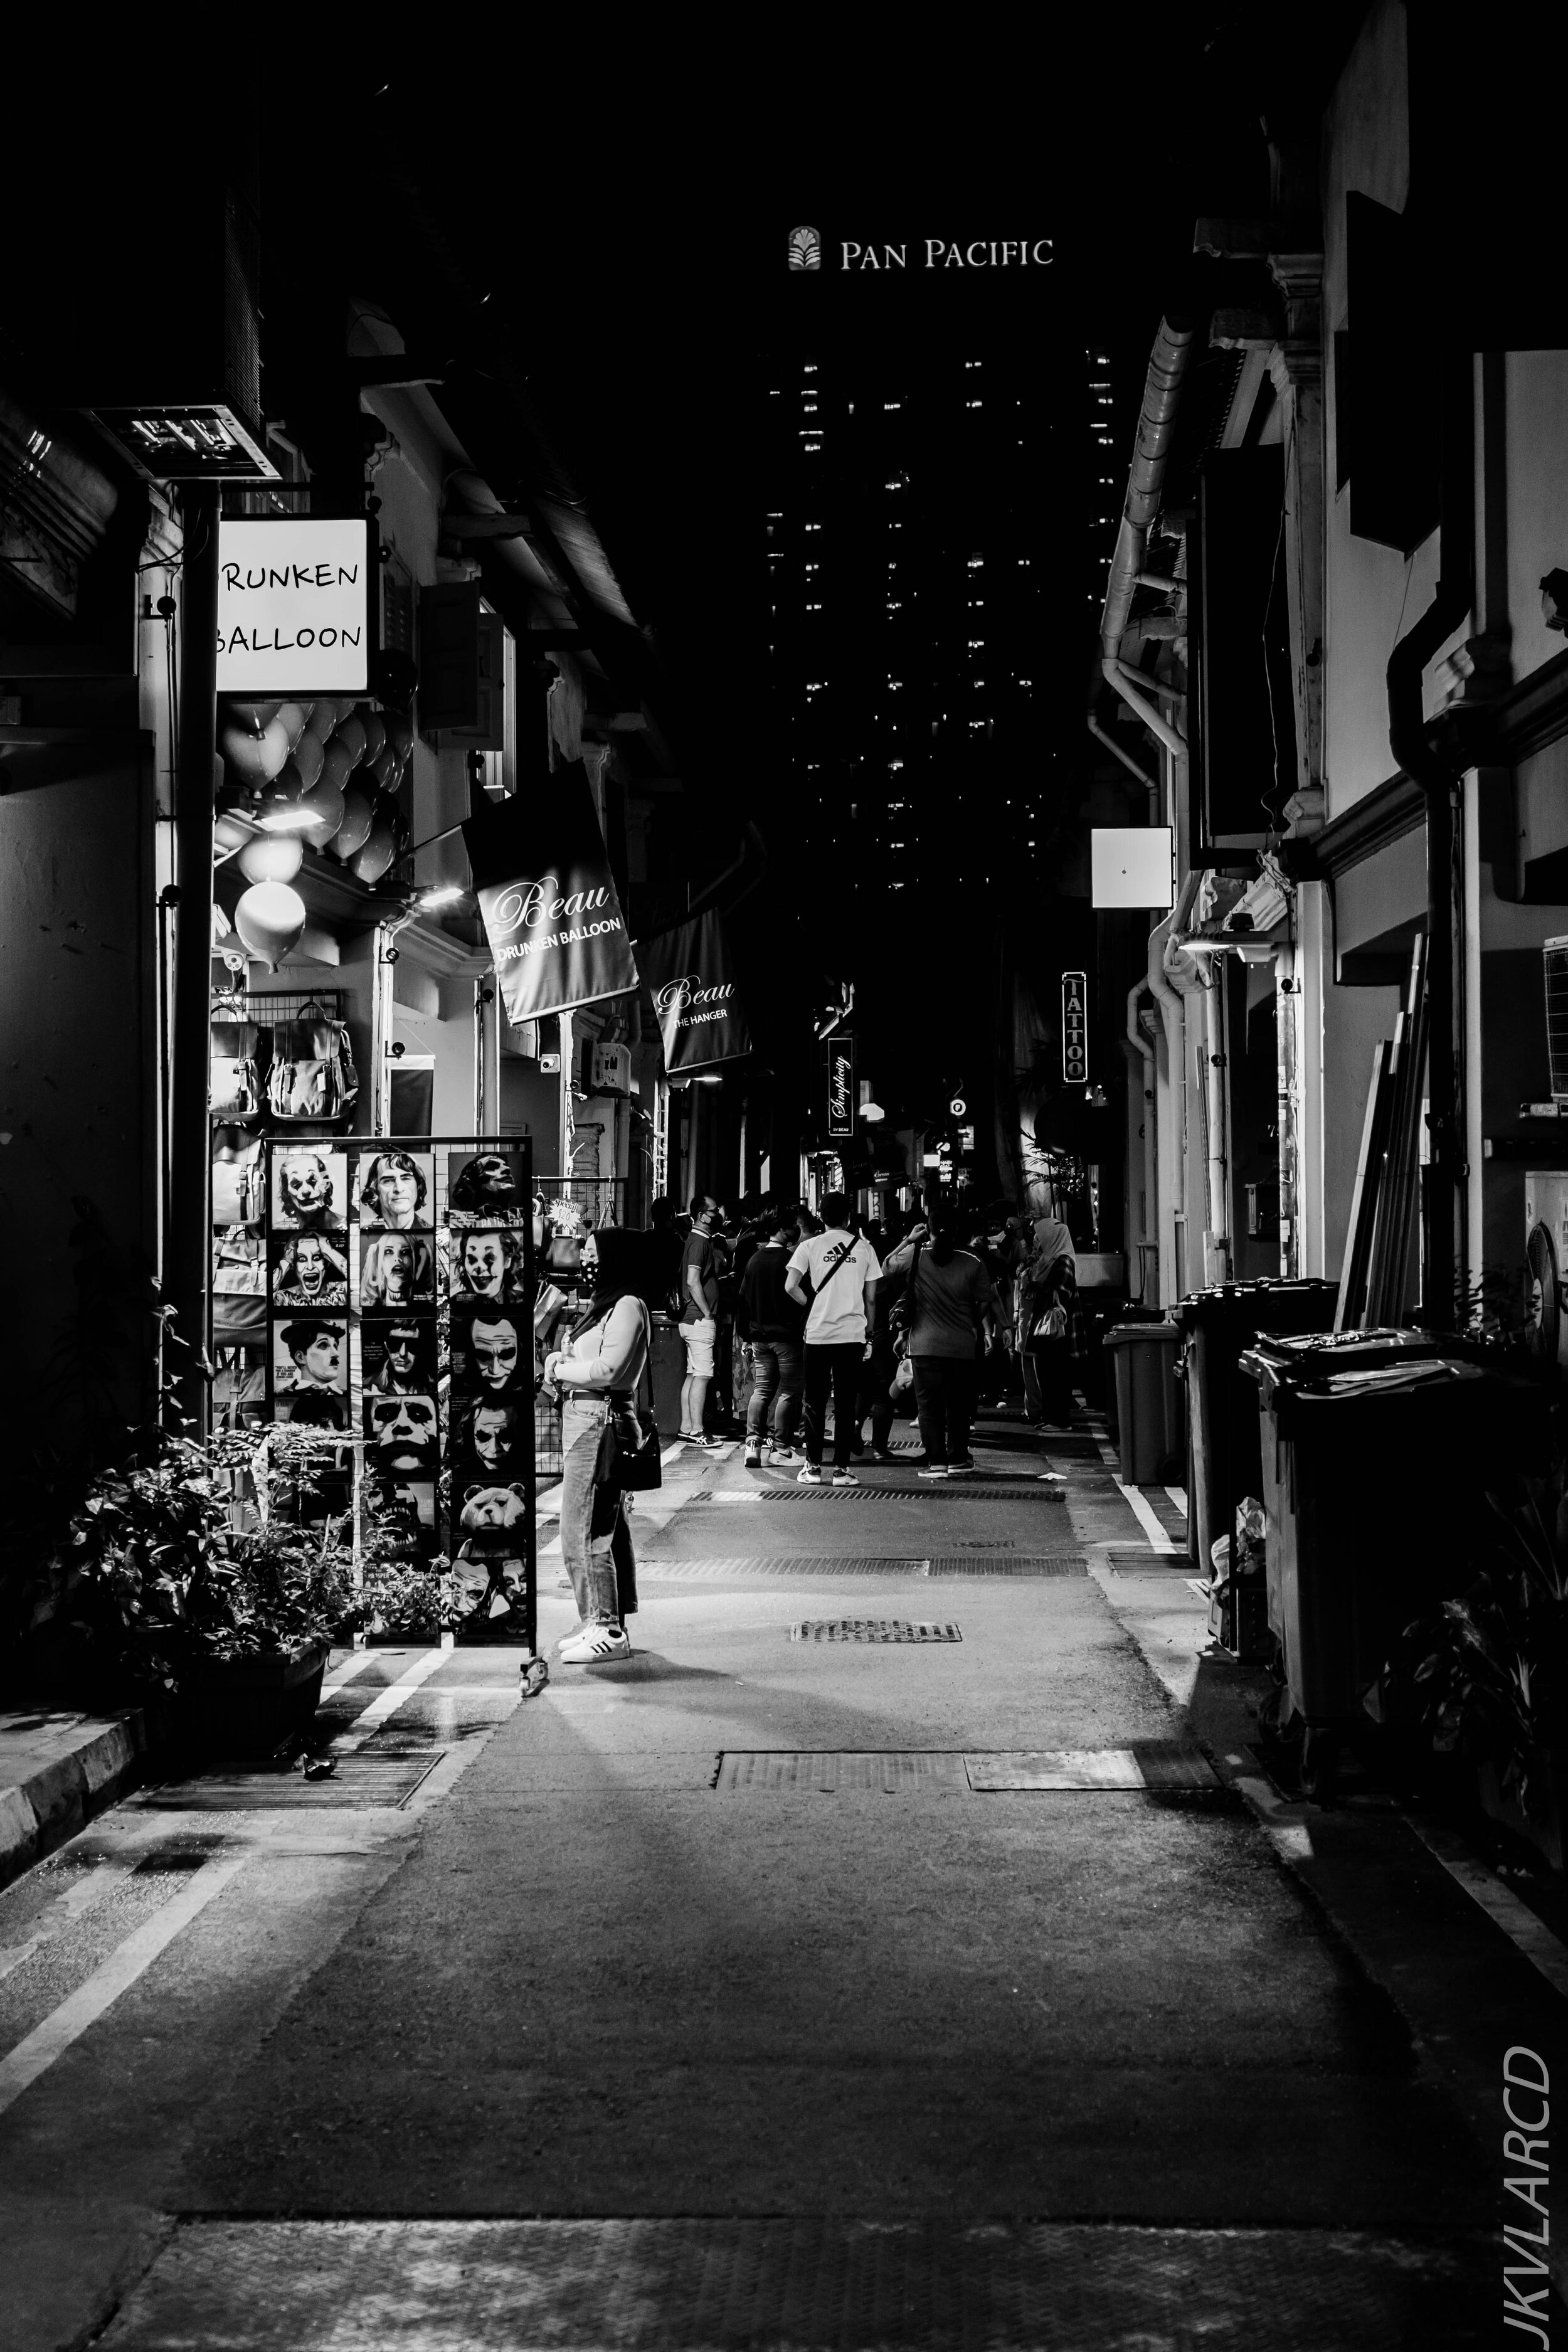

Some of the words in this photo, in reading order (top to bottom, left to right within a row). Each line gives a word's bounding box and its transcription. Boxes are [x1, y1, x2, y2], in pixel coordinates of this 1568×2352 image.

[839, 241, 908, 271] PAN
[923, 239, 1054, 268] PACIFIC
[221, 562, 359, 591] RUNKEN
[491, 876, 610, 935] Beau
[494, 934, 559, 961] DRUNKEN
[559, 916, 622, 945] BALLOON
[657, 975, 736, 1015] Beau
[689, 1008, 728, 1025] HANGER
[1063, 978, 1086, 1077] TATTOO
[829, 1055, 852, 1119] Simplicity
[1268, 1124, 1279, 1138] 7
[554, 1199, 578, 1212] special
